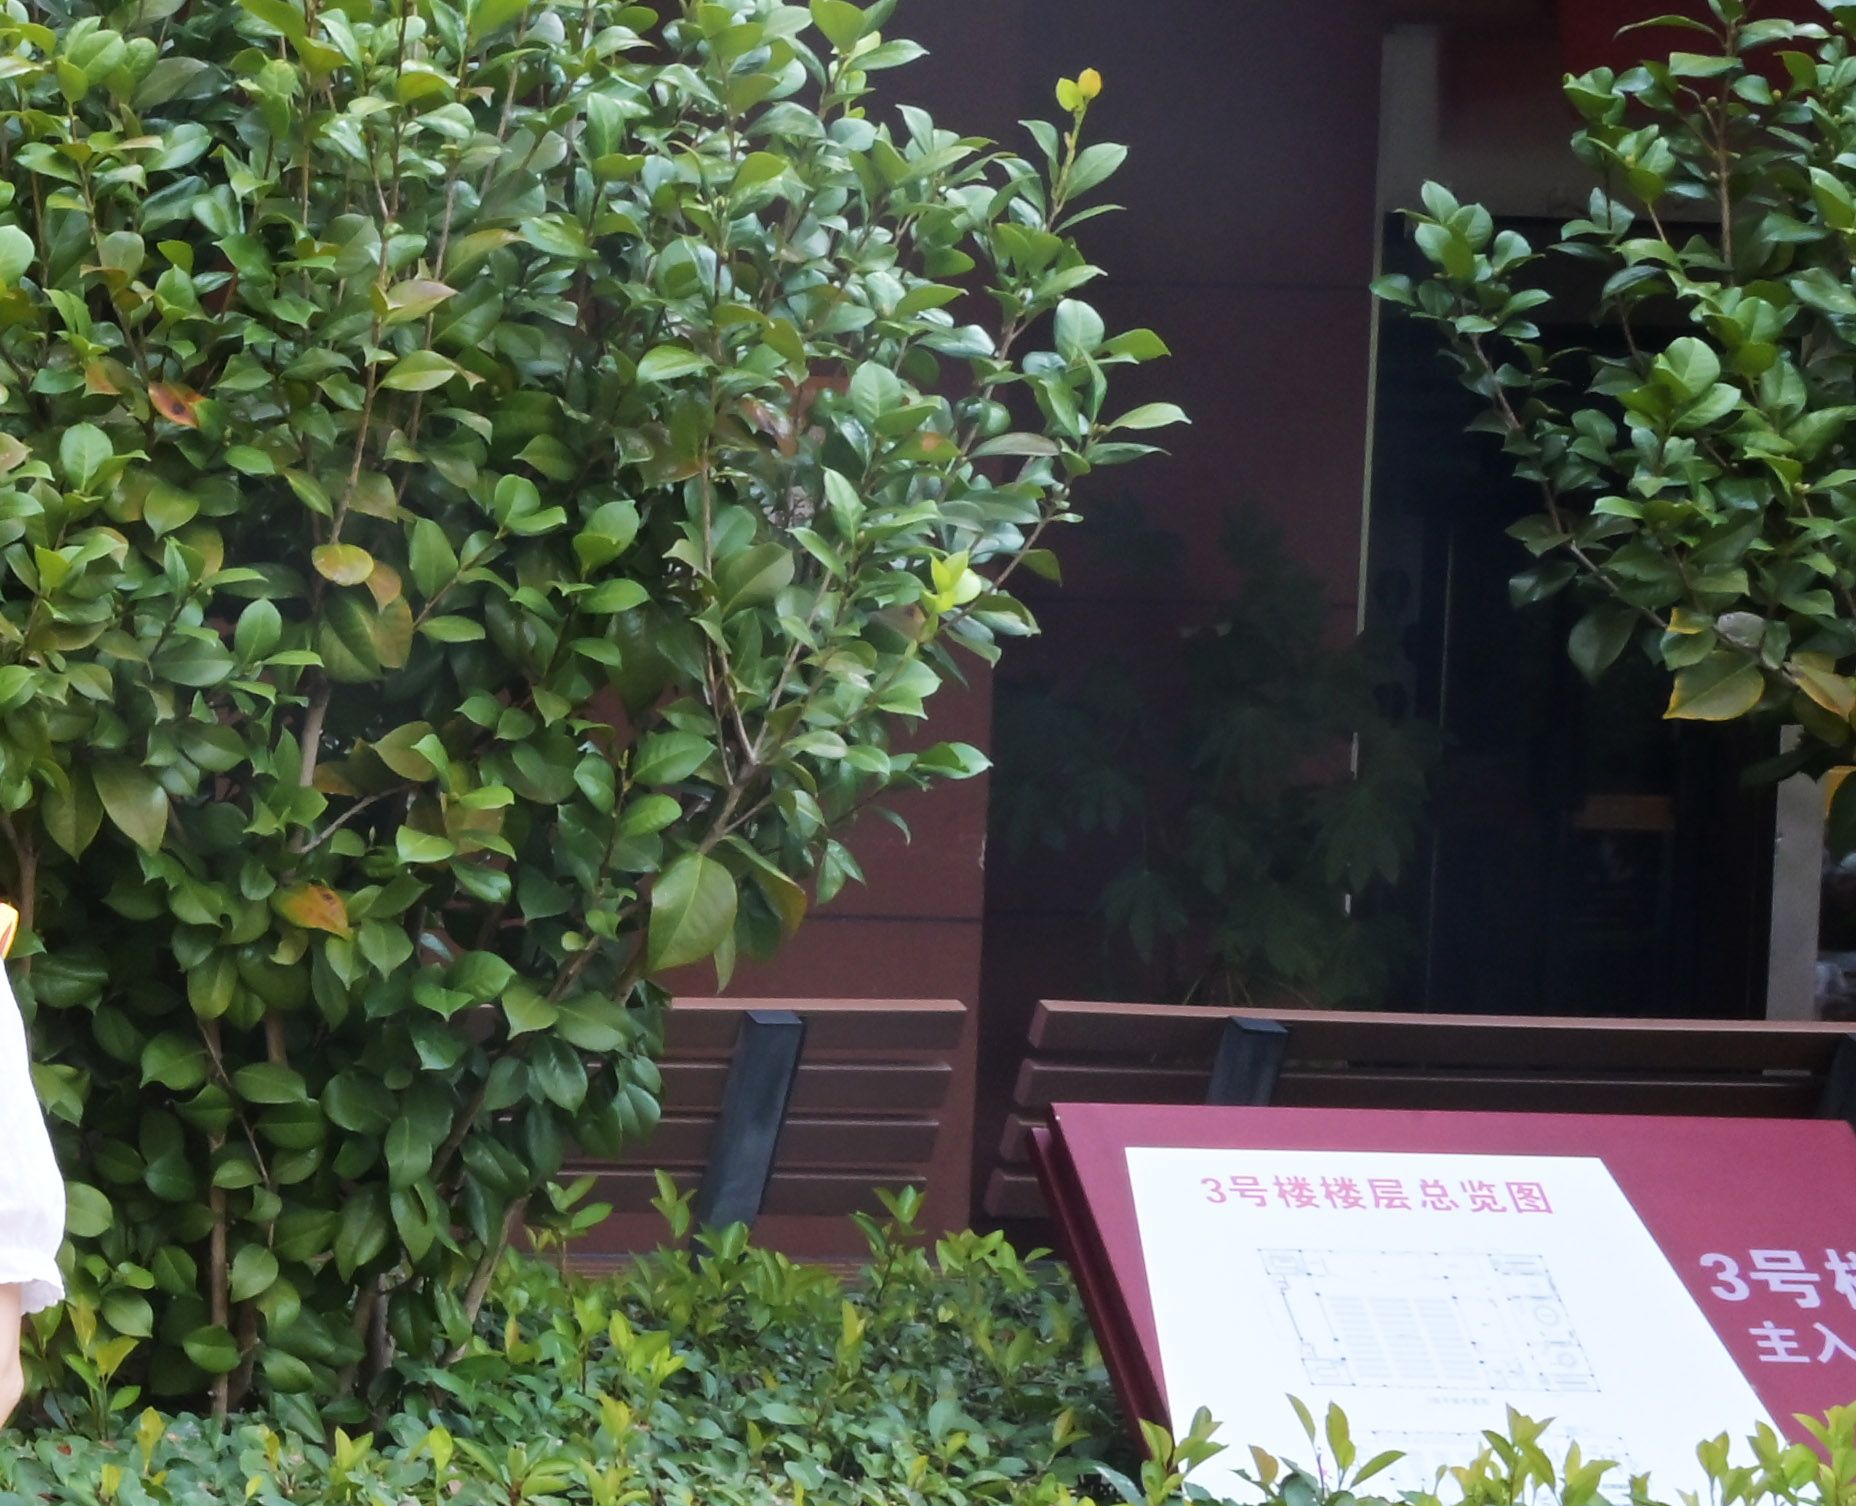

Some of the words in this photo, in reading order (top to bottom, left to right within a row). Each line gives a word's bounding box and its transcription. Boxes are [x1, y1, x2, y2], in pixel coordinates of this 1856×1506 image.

[1200, 1174, 1554, 1214] 3号楼楼层总览图
